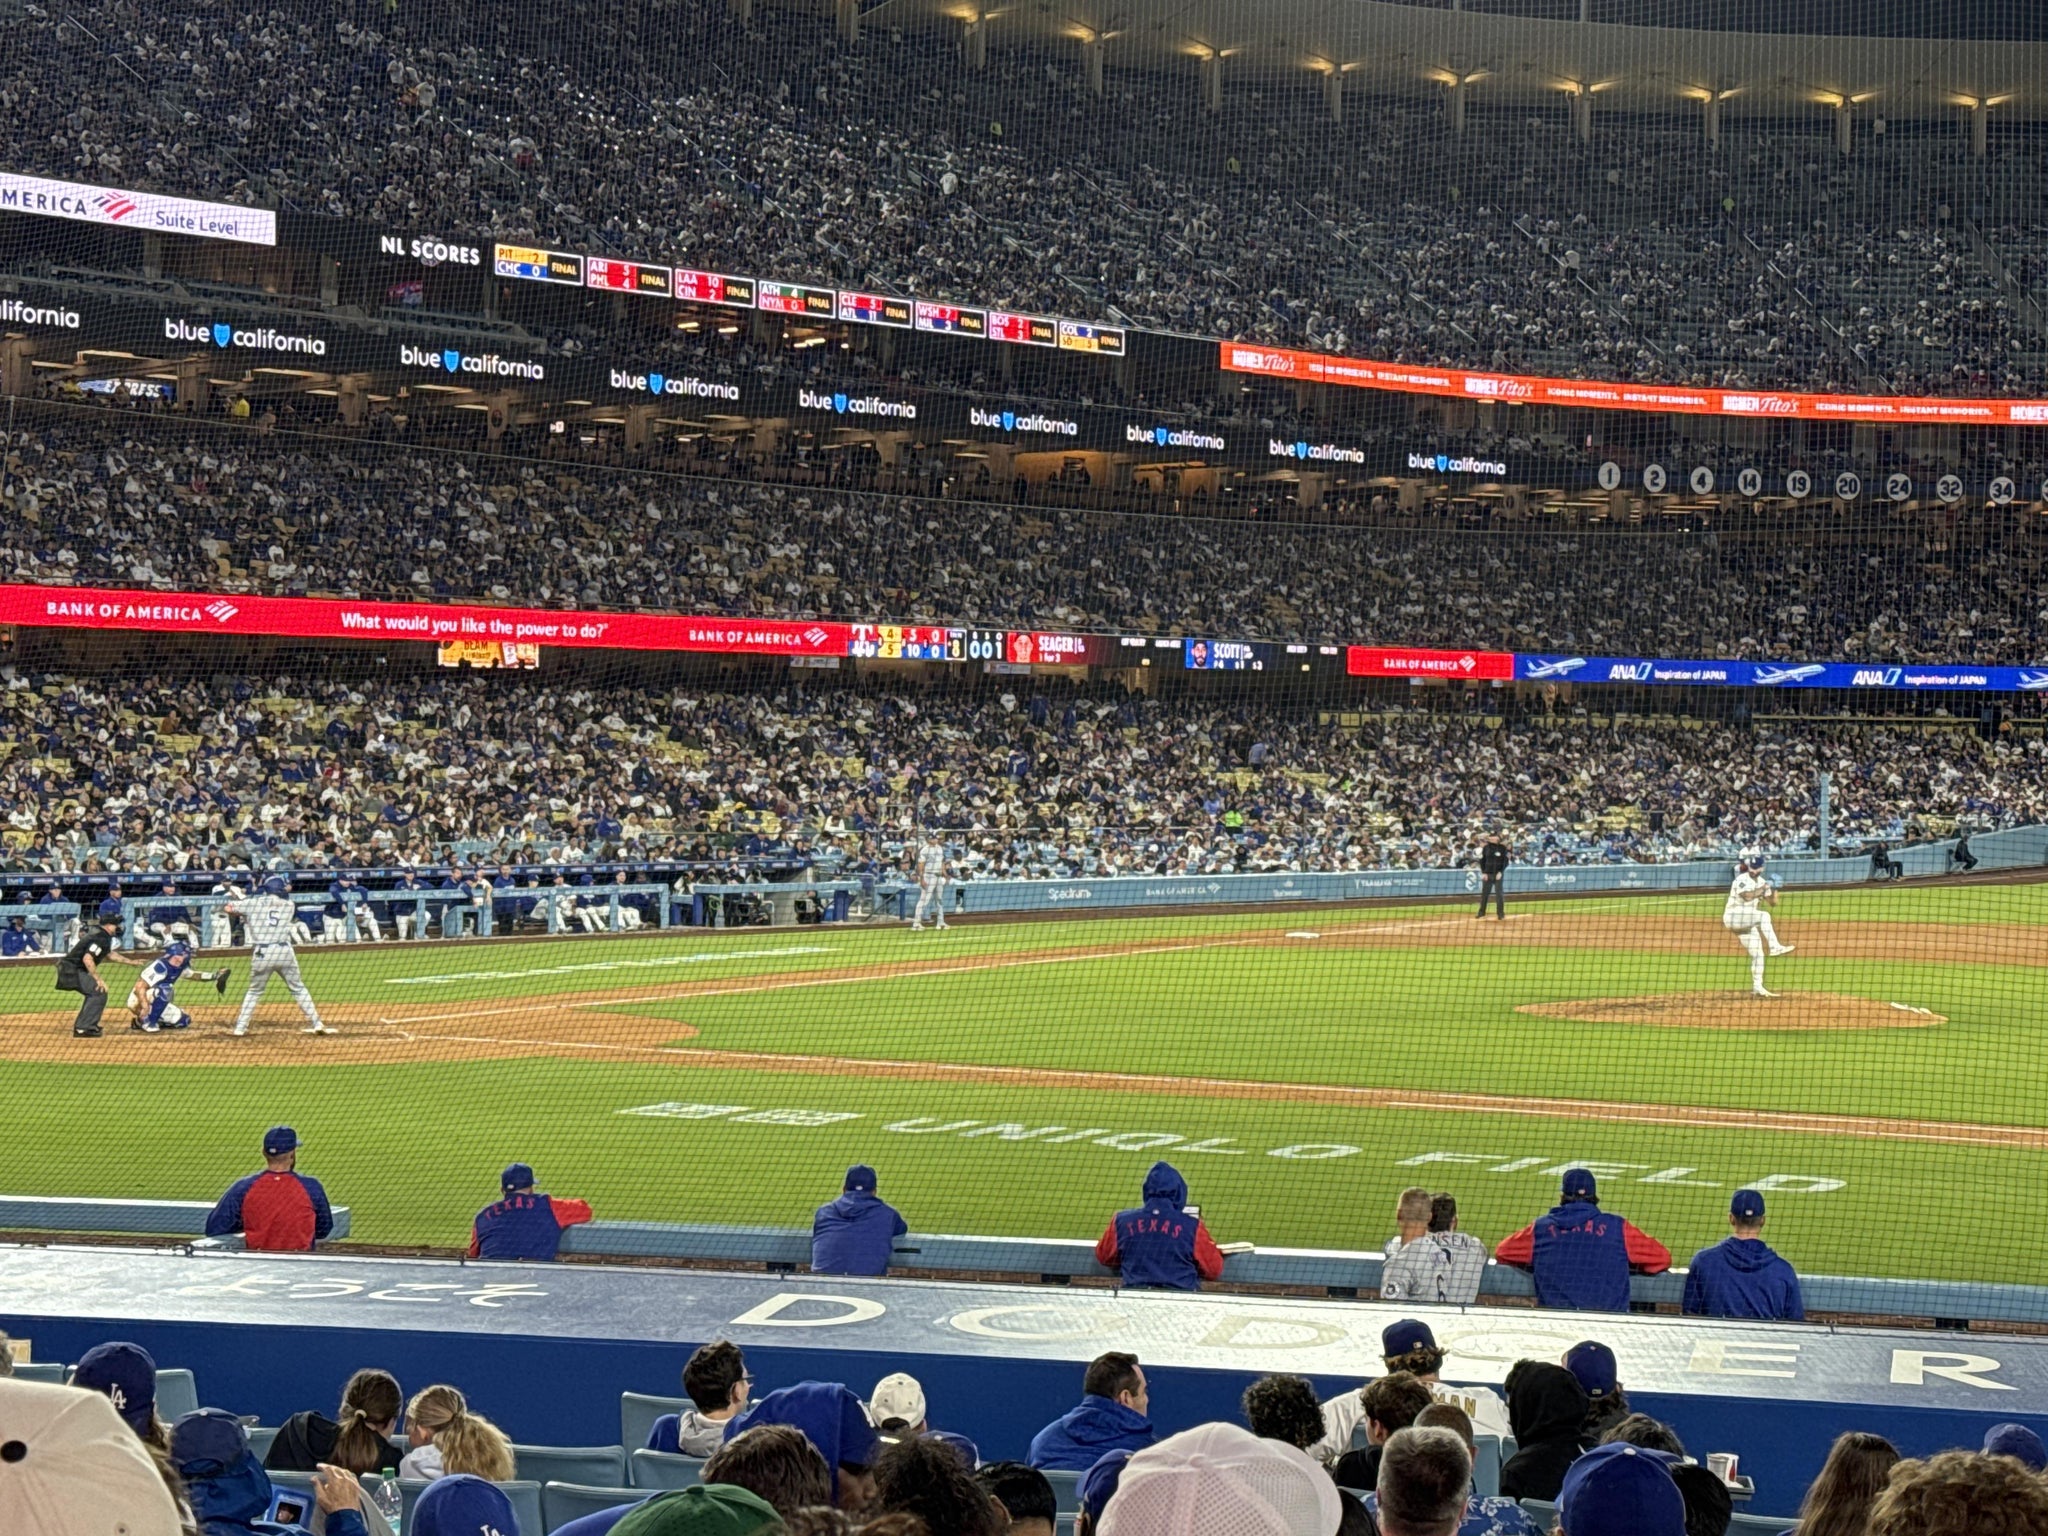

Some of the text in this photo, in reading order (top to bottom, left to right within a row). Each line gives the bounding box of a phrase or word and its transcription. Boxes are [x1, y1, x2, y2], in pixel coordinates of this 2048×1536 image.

[155, 210, 195, 230] Suite
[198, 213, 239, 236] Level
[381, 235, 480, 266] NL SCORES
[500, 248, 539, 263] PIT 2
[500, 261, 540, 277] CHC 0
[552, 262, 578, 275] FINAL
[590, 261, 630, 275] ARI 5
[590, 274, 630, 289] PHL 4
[641, 274, 666, 287] FINAL
[678, 273, 719, 289] LAA 10
[678, 286, 716, 300] CIN 2
[726, 285, 750, 298] FINAL
[761, 284, 798, 297] ATH 4
[761, 296, 798, 310] NYM 0
[807, 297, 830, 309] FINAL
[841, 295, 876, 309] CLE 5
[0, 300, 80, 329] lifornia
[841, 307, 877, 321] ATL 11
[885, 307, 907, 319] FINAL
[918, 304, 951, 319] WSH 7
[918, 317, 952, 331] MIL 3
[960, 317, 981, 329] FINAL
[991, 315, 1024, 329] BOS 2
[165, 318, 326, 356] blue california
[992, 327, 1024, 340] STL 3
[1032, 326, 1052, 339] FINAL
[1061, 325, 1093, 337] COL 2
[1063, 336, 1073, 346] SD
[1100, 335, 1120, 347] FINAL
[401, 344, 544, 380] blue california
[1264, 353, 1296, 374] Tito's
[610, 369, 739, 400] blue california
[1498, 379, 1534, 398] Tito's
[800, 389, 916, 419] blue california
[1759, 396, 1800, 414] Tito's
[971, 408, 1077, 436] blue california
[1127, 425, 1225, 451] blue california
[1270, 439, 1364, 464] blue california
[1408, 453, 1507, 476] blue california
[1606, 467, 1614, 485] 1
[1649, 469, 1660, 487] 2
[1696, 471, 1708, 489] 4
[1741, 473, 1758, 492] 14
[1790, 474, 1808, 493] 19
[1839, 476, 1858, 495] 20
[1889, 478, 1910, 497] 24
[1939, 480, 1961, 498] 32
[1992, 482, 2014, 500] 34
[47, 601, 202, 622] BANK OF AMERICA
[341, 612, 381, 629] What
[385, 613, 428, 632] would
[432, 619, 458, 636] you
[461, 617, 487, 633] like
[490, 618, 513, 635] the
[516, 622, 559, 639] power
[563, 623, 577, 637] to
[852, 624, 940, 643] T 4 5 0
[689, 629, 802, 646] BANK OF AMERICA
[1039, 636, 1073, 652] SEAGER
[887, 644, 894, 656] 5
[907, 644, 921, 657] 10
[931, 645, 940, 658] 0
[952, 639, 960, 658] 8
[970, 640, 1002, 660] 0 0 1
[1213, 643, 1241, 659] SCOTT
[1055, 653, 1061, 662] 3
[1383, 658, 1458, 671] BANK OF AMERICA
[1609, 664, 1637, 681] ANA
[1654, 668, 1727, 682] Inspiration of JAPAN
[1852, 670, 1884, 686] ANA
[1904, 674, 1987, 687] Inspiration of JAPAN
[268, 910, 280, 927] 5
[881, 1116, 1364, 1159] UNIQLO
[1394, 1150, 1848, 1193] FIELD
[484, 1195, 535, 1221] TEXAS
[1127, 1219, 1182, 1239] TEXAS
[178, 1276, 549, 1308] ようこそ
[110, 1383, 127, 1411] LA
